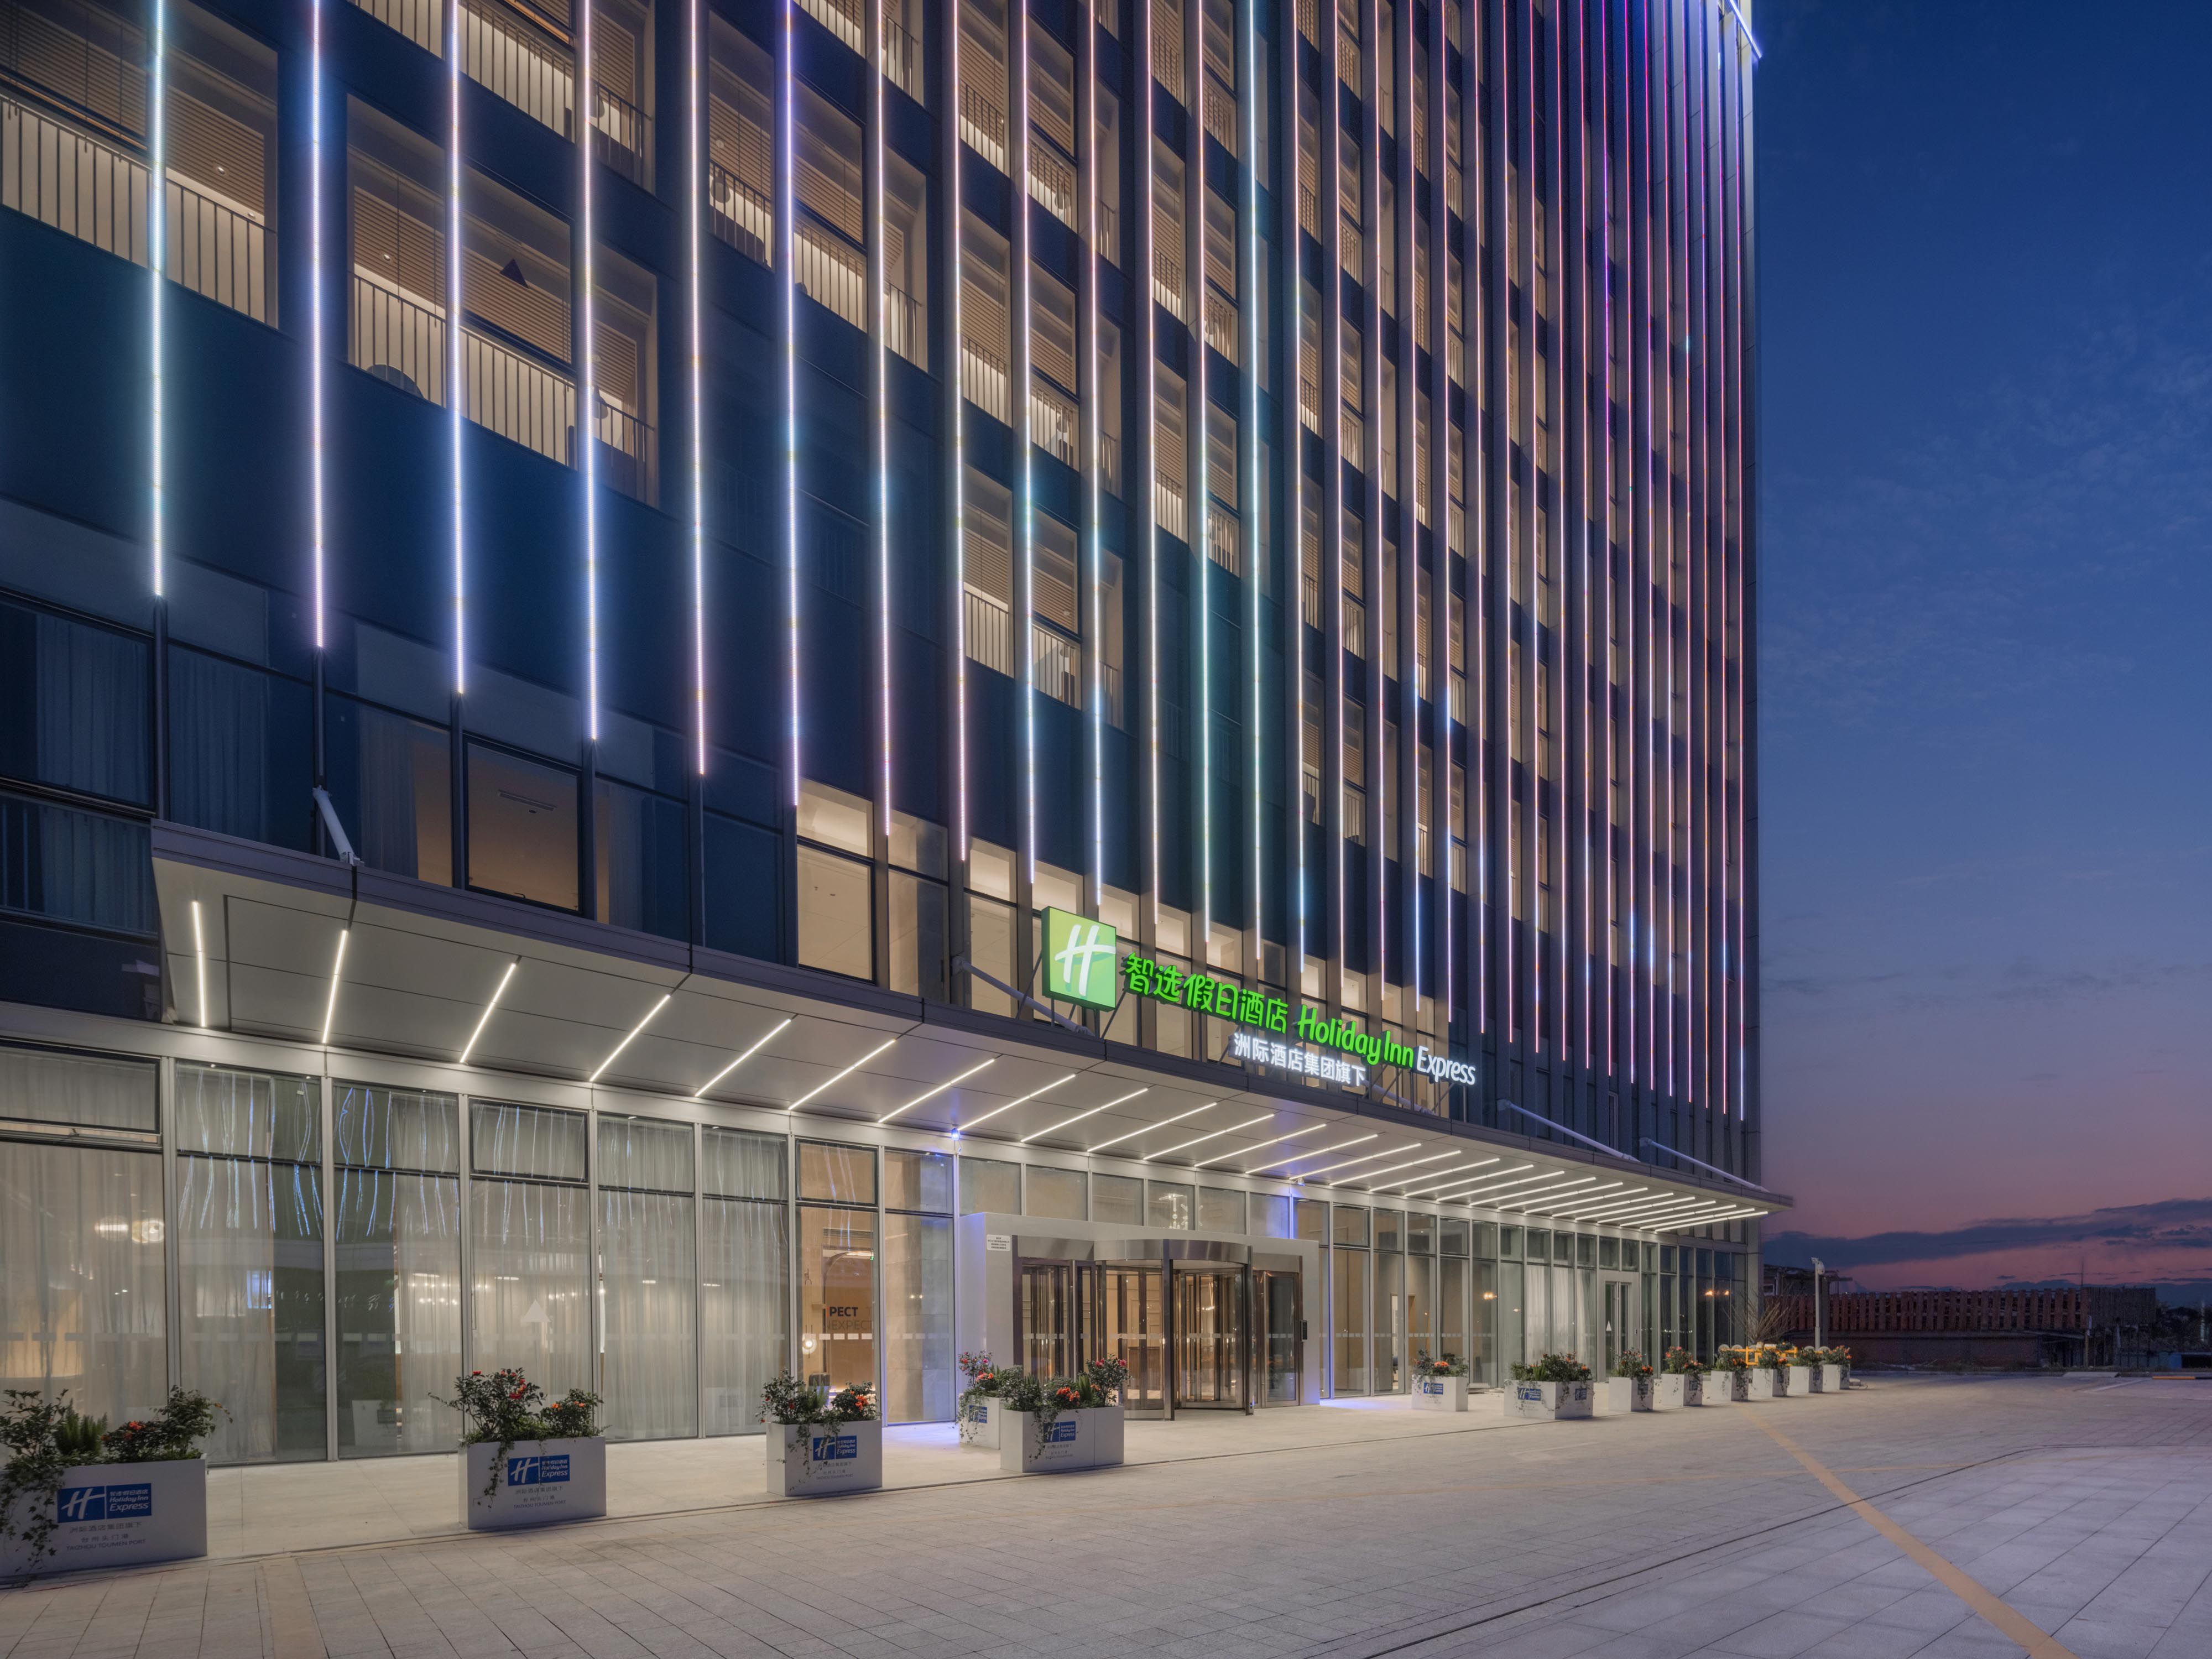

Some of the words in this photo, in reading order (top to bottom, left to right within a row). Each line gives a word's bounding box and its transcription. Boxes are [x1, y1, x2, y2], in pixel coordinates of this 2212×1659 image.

[1125, 952, 1288, 1034] 智选假日酒店
[1297, 1004, 1381, 1065] Holiday
[1384, 1030, 1414, 1068] Inn
[1416, 1046, 1475, 1086] Express
[1234, 1032, 1366, 1087] 洲际酒店集团旗下
[109, 1503, 149, 1512] Express
